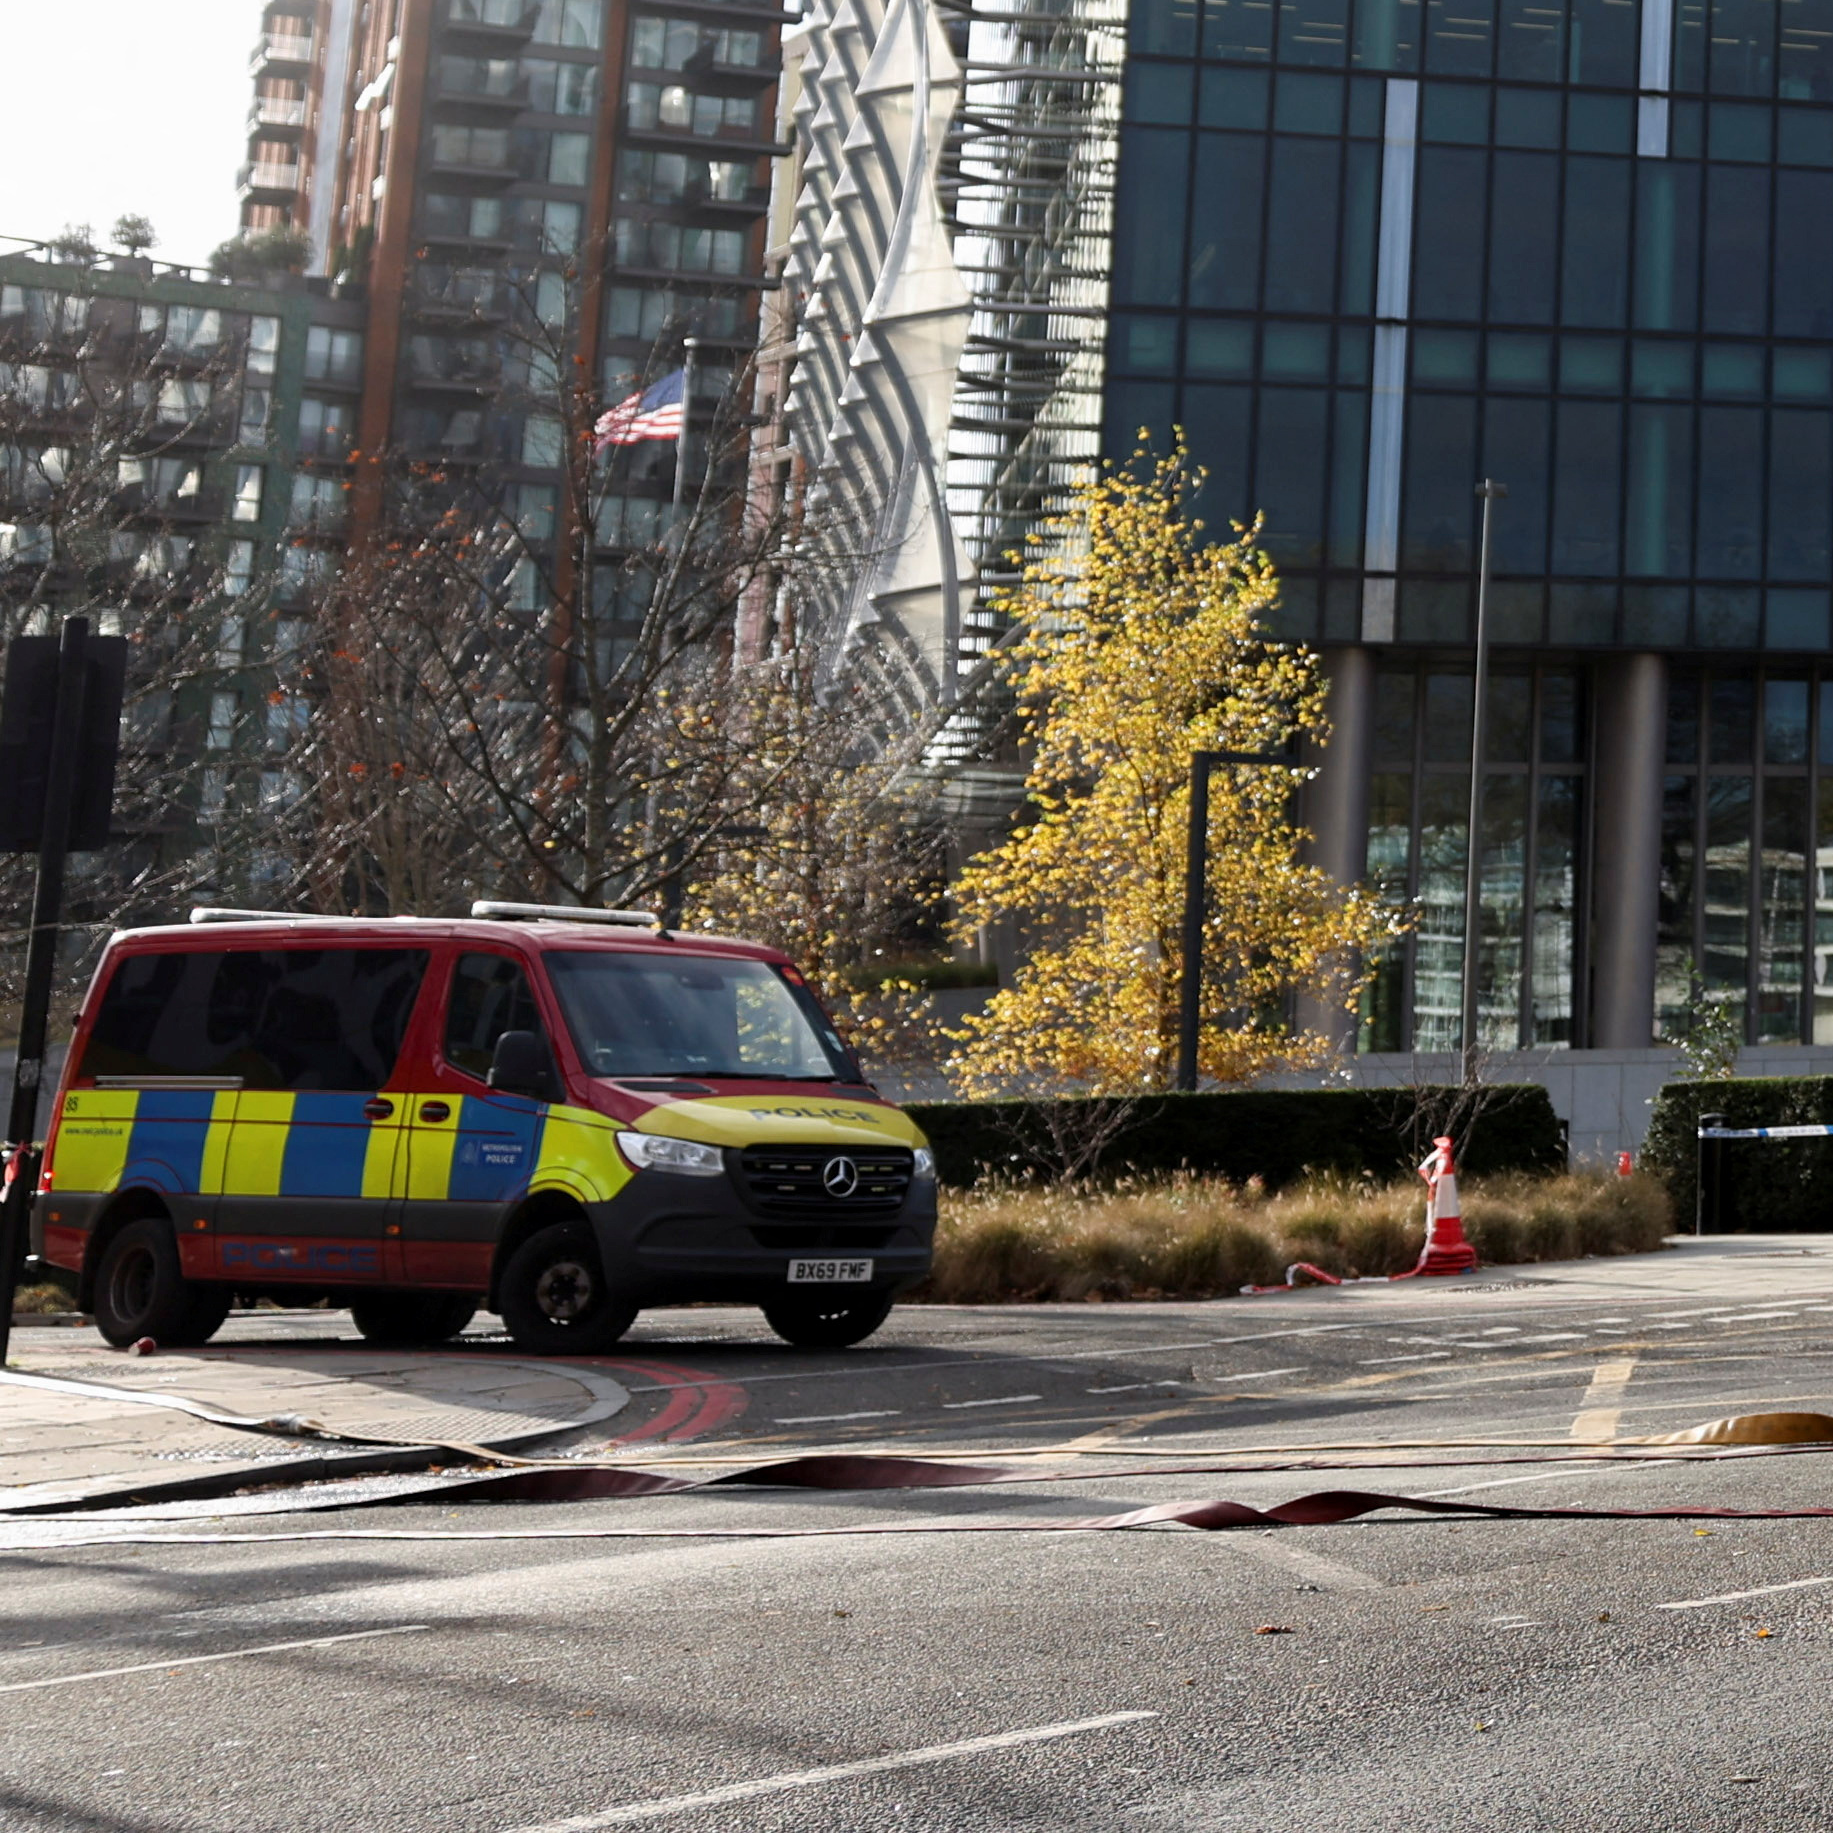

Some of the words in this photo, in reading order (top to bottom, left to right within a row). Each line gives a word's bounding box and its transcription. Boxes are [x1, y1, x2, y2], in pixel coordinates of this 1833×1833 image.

[749, 1107, 880, 1123] POLICE
[485, 1154, 517, 1164] POLICE
[223, 1242, 377, 1271] POLICE
[796, 1262, 836, 1279] BX69
[839, 1262, 867, 1279] FMF
